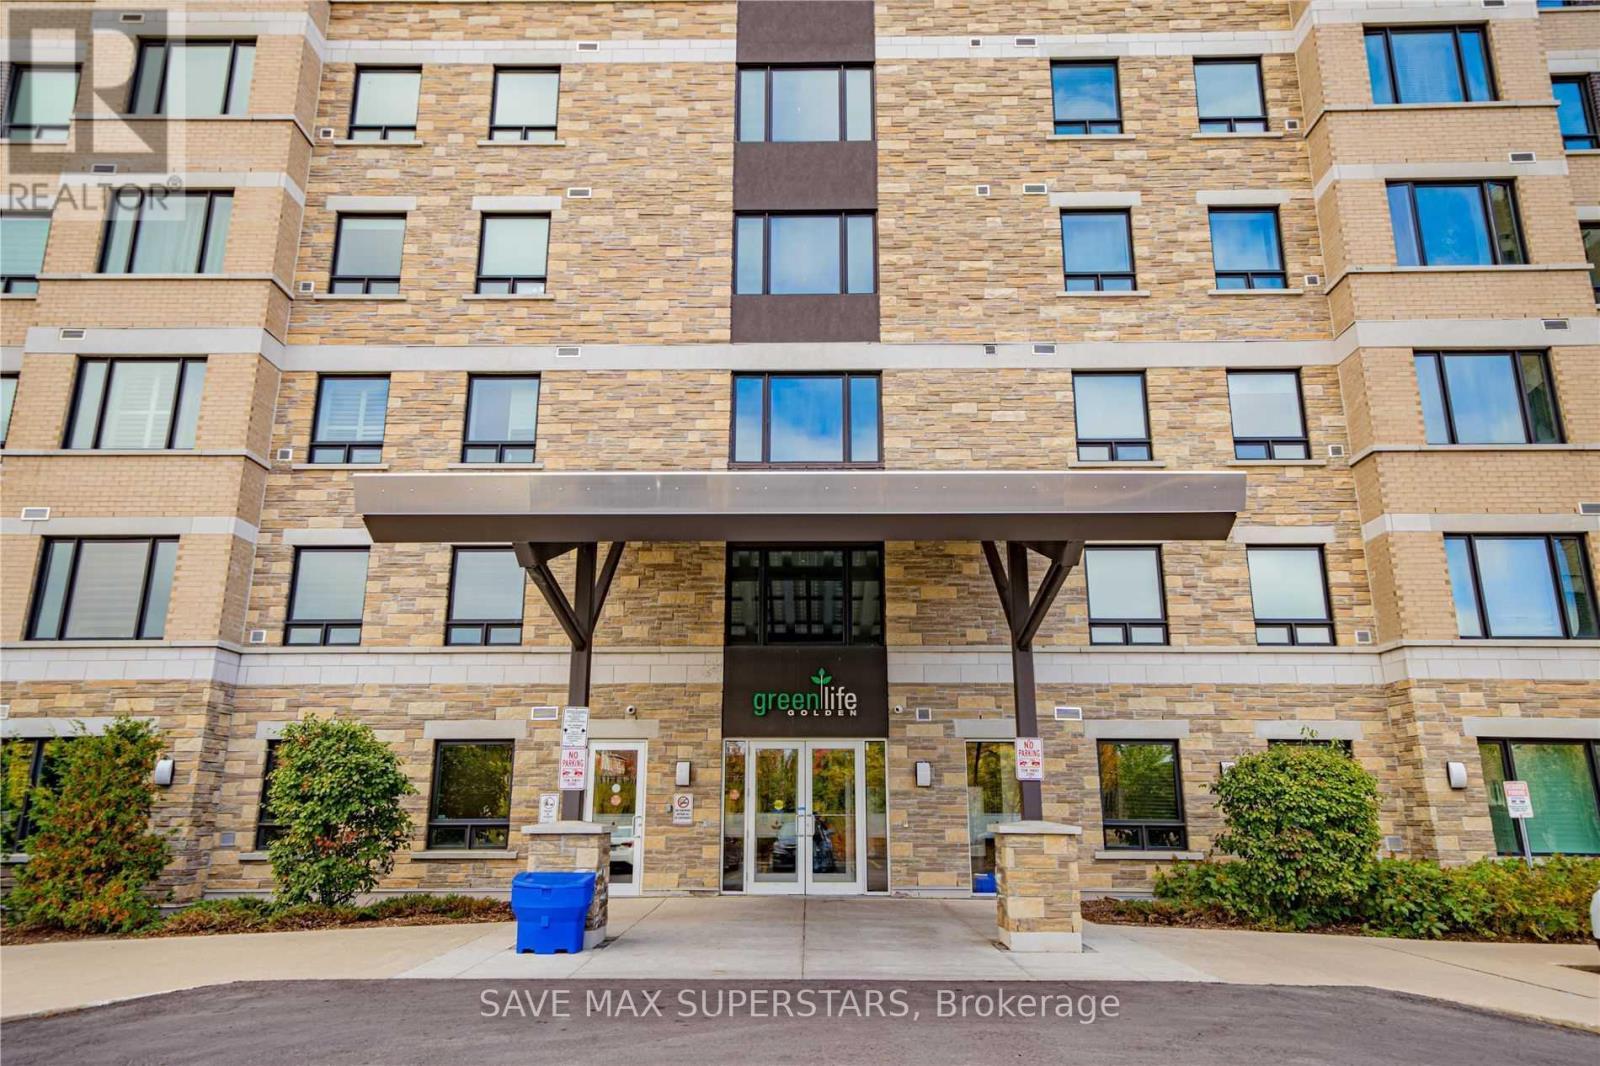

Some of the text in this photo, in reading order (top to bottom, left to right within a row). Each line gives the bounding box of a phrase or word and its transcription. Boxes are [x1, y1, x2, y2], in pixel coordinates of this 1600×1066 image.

[787, 709, 857, 717] GOLDEN
[1023, 741, 1034, 749] NO
[568, 751, 579, 759] NO
[1018, 749, 1040, 757] PARKING
[561, 759, 584, 767] PARKING
